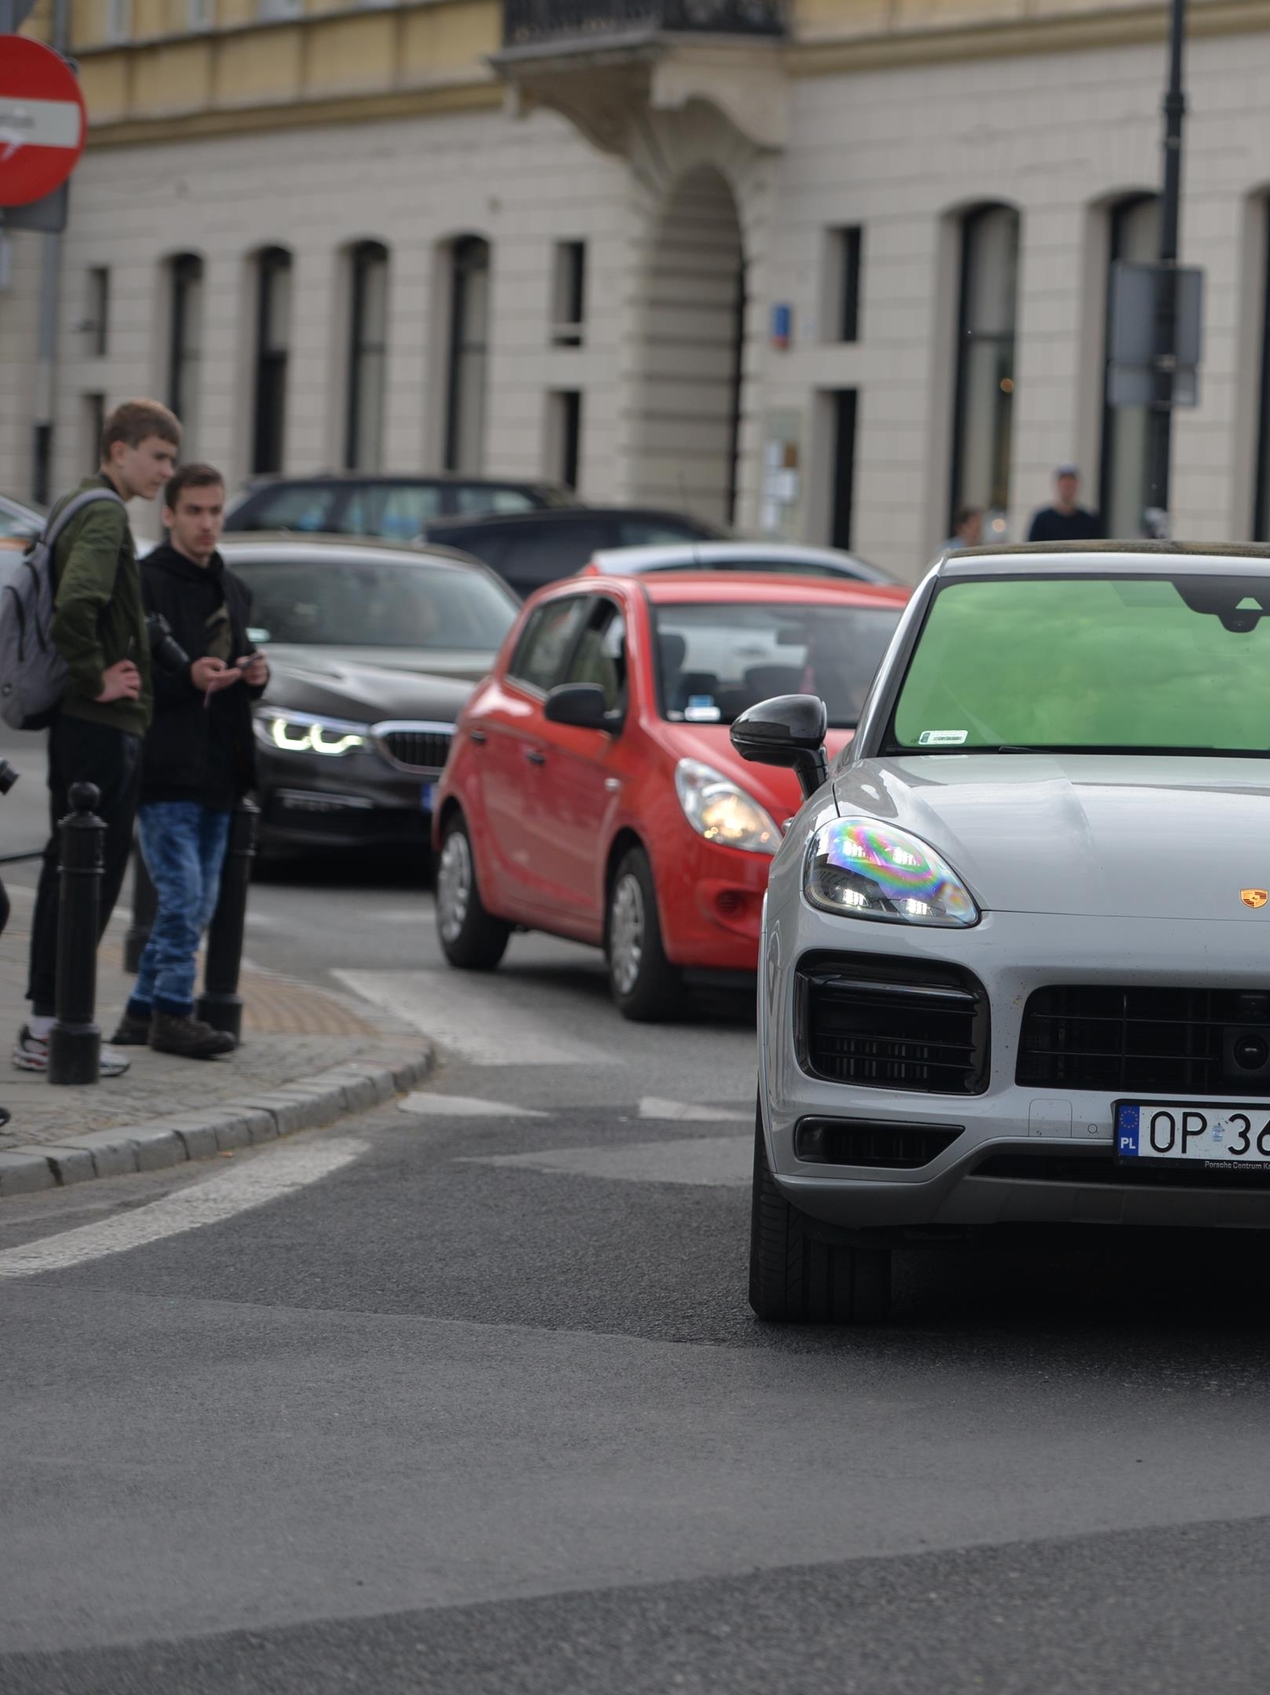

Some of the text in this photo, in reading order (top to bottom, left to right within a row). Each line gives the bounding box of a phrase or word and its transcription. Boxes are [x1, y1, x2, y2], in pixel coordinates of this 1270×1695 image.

[1150, 1111, 1207, 1154] OP
[1120, 1137, 1136, 1149] PL
[1204, 1160, 1232, 1169] Porsche
[1232, 1161, 1262, 1170] Centrum
